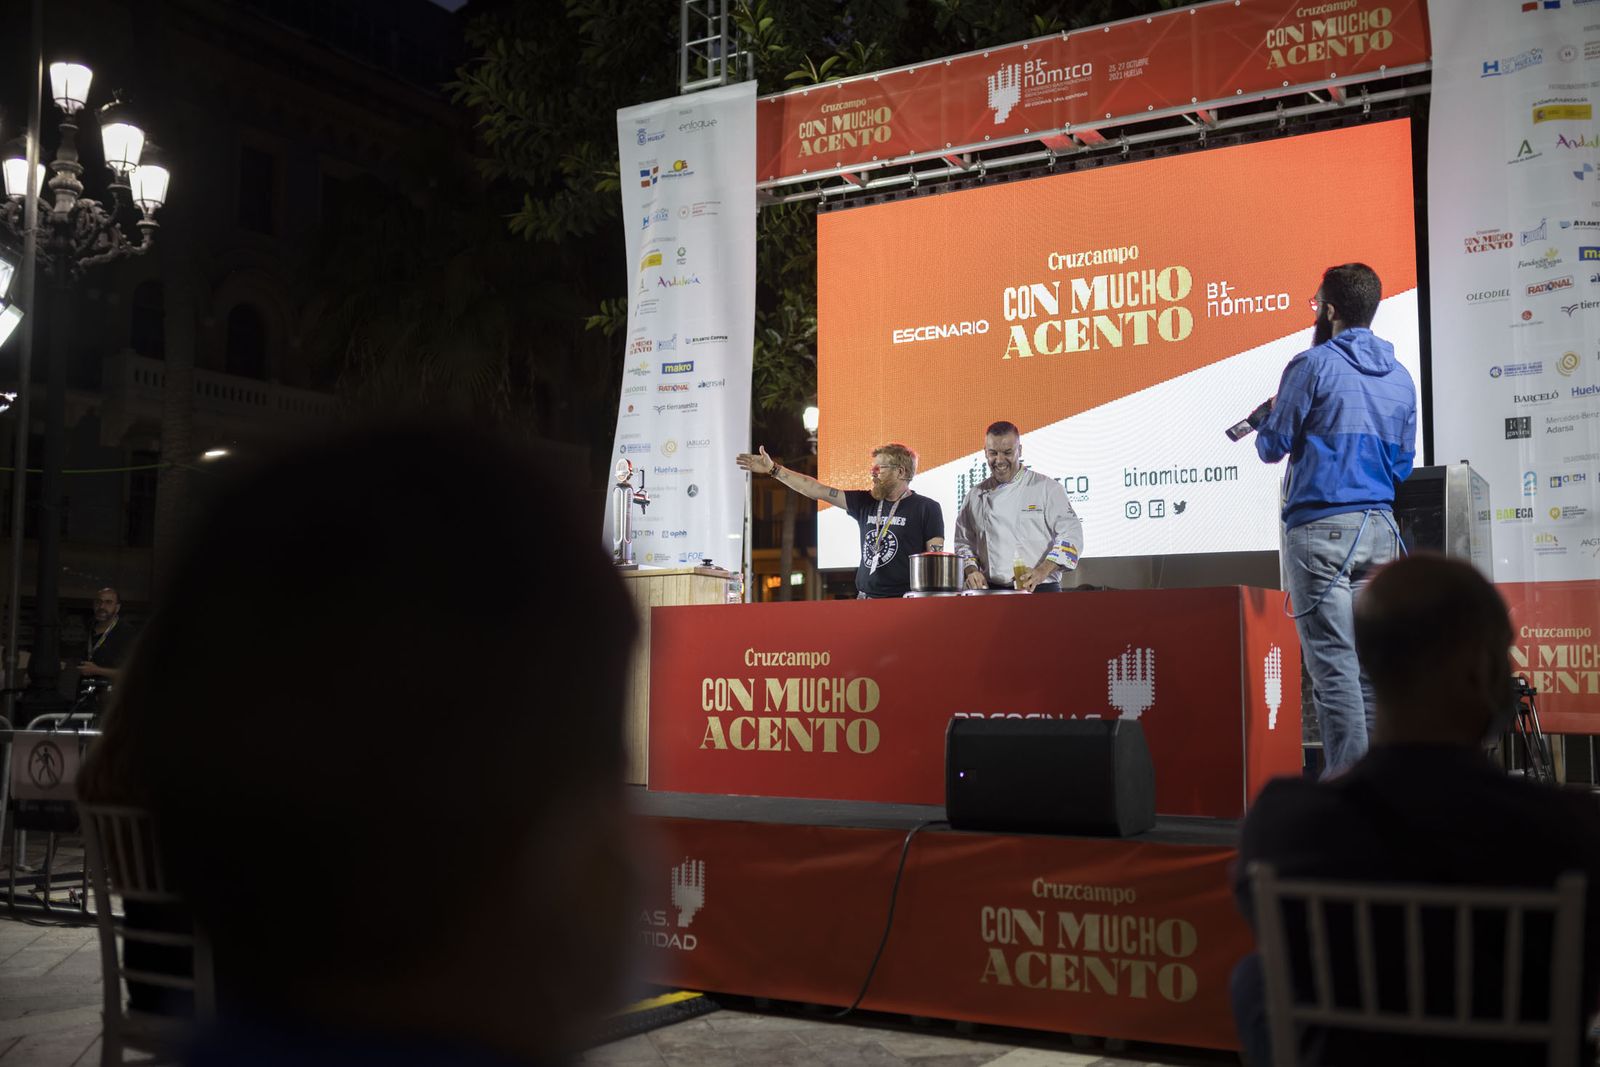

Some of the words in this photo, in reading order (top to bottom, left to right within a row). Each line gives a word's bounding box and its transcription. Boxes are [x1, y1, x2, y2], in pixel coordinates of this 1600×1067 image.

[1296, 0, 1358, 18] Cruzcampo
[1266, 23, 1304, 49] CON
[1311, 7, 1393, 41] MUCHO
[1266, 29, 1394, 70] ACENTO
[821, 98, 867, 114] Cruzcampo
[799, 118, 828, 139] CON
[832, 106, 892, 133] MUCHO
[798, 124, 893, 158] ACENTO
[1464, 240, 1514, 255] ACENTO
[1482, 231, 1514, 245] MUCHO
[1048, 244, 1139, 270] Cruzcampo
[1003, 280, 1061, 321] CON
[1070, 265, 1193, 315] MUCHO
[1466, 288, 1512, 302] OLEODIEL
[1527, 278, 1573, 295] RATIONAL
[892, 319, 990, 344] ESCENARIO
[1002, 306, 1194, 360] ACENTO
[664, 362, 693, 374] makro
[658, 384, 690, 393] RATIONAL
[1546, 424, 1575, 434] Adarsa
[654, 466, 679, 475] Huelva
[1520, 625, 1593, 640] Cruzcampo
[745, 648, 831, 669] Cruzcampo
[702, 677, 756, 712] CON
[764, 676, 881, 714] MUCHO
[699, 716, 881, 754] ACENTO
[1031, 876, 1137, 906] Cruzcampo
[980, 905, 1047, 947] CON
[1056, 910, 1198, 958] MUCHO
[979, 947, 1198, 1003] ACENTO
